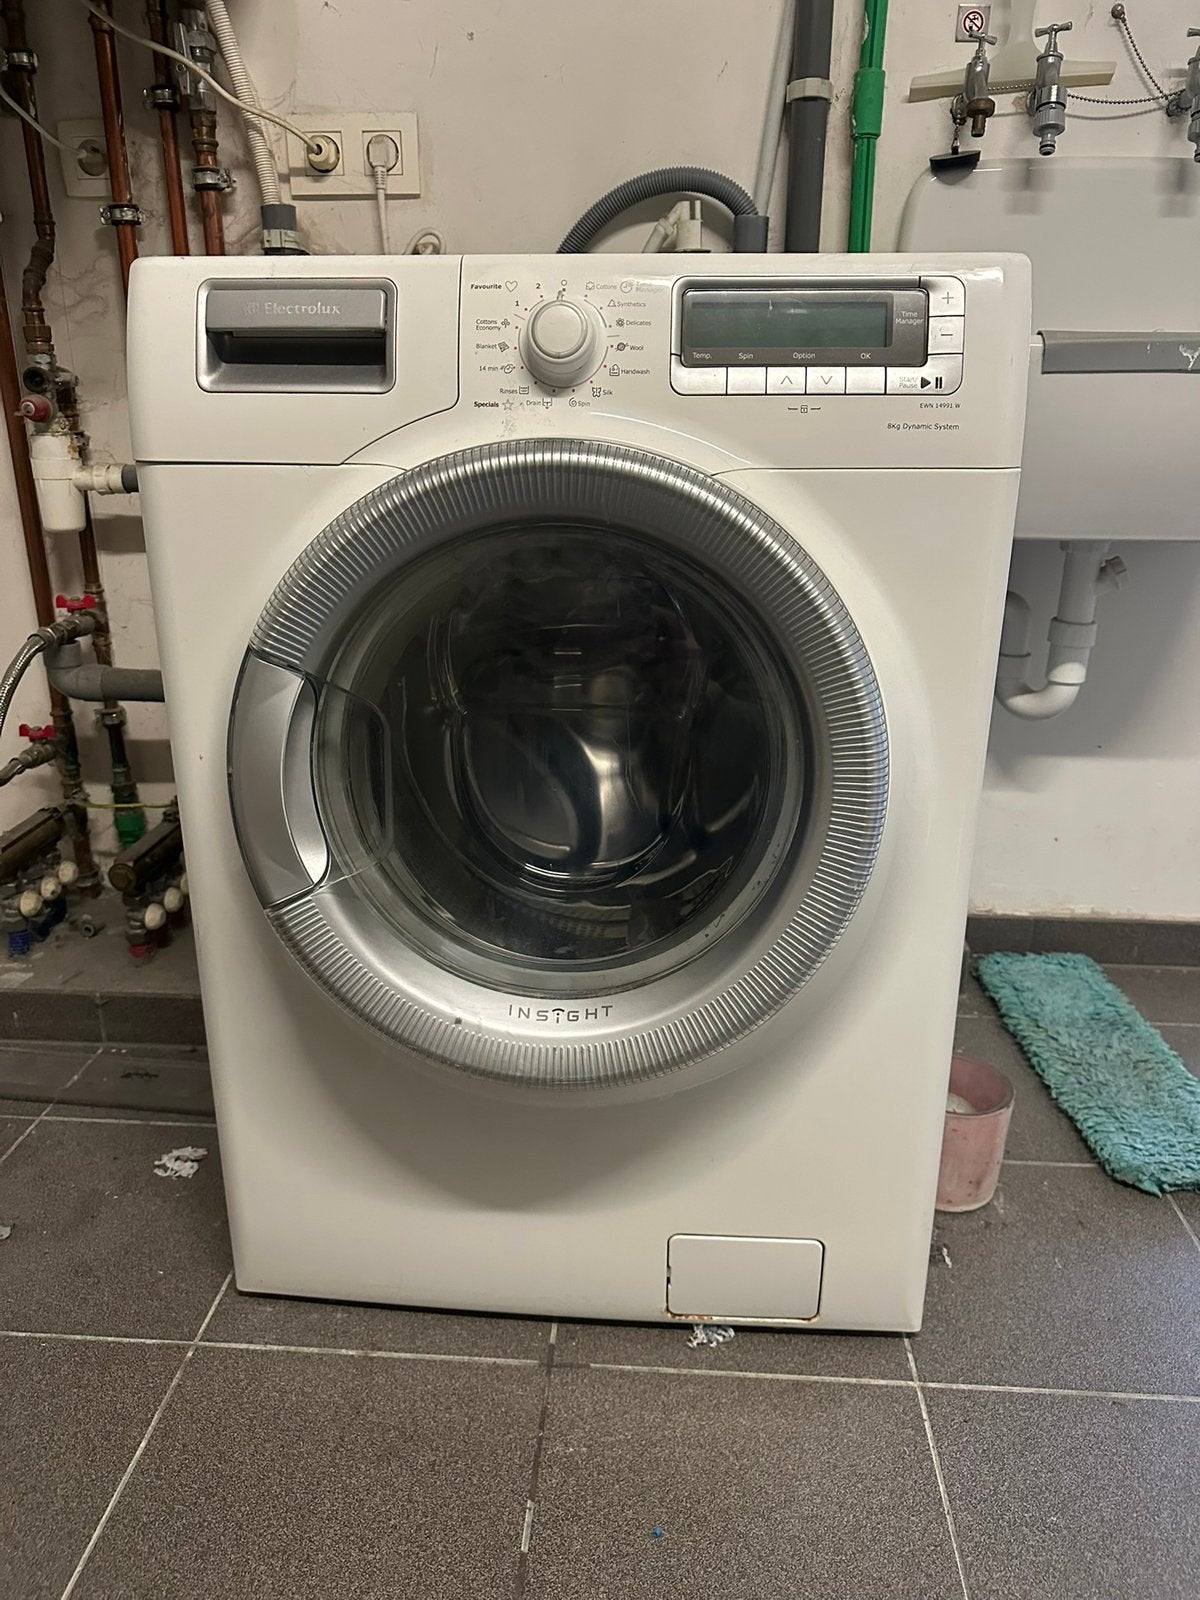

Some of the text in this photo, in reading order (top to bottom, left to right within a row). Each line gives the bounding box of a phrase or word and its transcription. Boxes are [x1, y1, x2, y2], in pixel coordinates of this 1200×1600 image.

[616, 300, 647, 308] Synthetics
[264, 302, 341, 315] Electrolux
[895, 318, 924, 326] Manager
[692, 352, 713, 361] Temp.
[738, 352, 754, 361] Spin
[792, 351, 817, 361] Option
[860, 352, 872, 360] OK
[621, 366, 651, 375] Handwash
[473, 401, 500, 409] Specials
[526, 398, 542, 406] Drain
[577, 399, 591, 408] Spin
[887, 423, 960, 431] 8Kg Dynamic System
